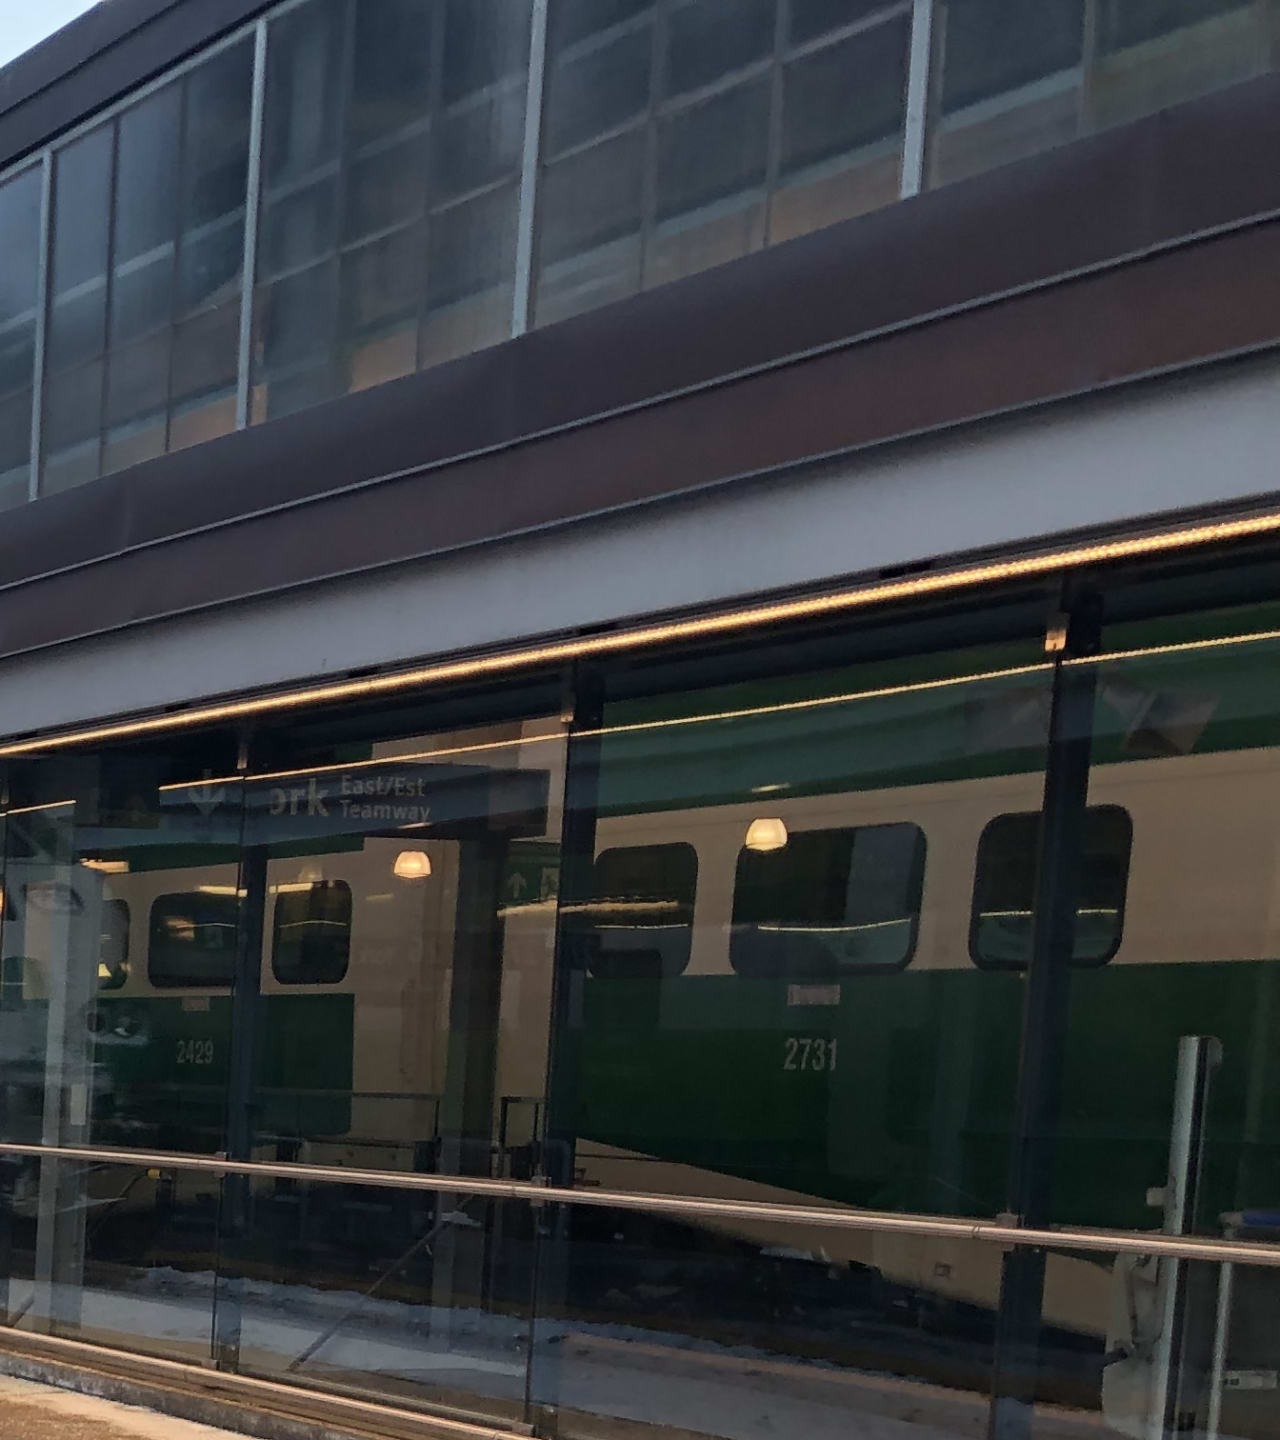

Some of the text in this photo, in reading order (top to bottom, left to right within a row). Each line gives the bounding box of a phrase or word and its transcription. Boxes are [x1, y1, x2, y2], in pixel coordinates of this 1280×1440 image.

[341, 774, 426, 798] East/Est
[342, 799, 432, 822] Teamway
[176, 1040, 214, 1064] 2429
[783, 1038, 837, 1071] 2731
